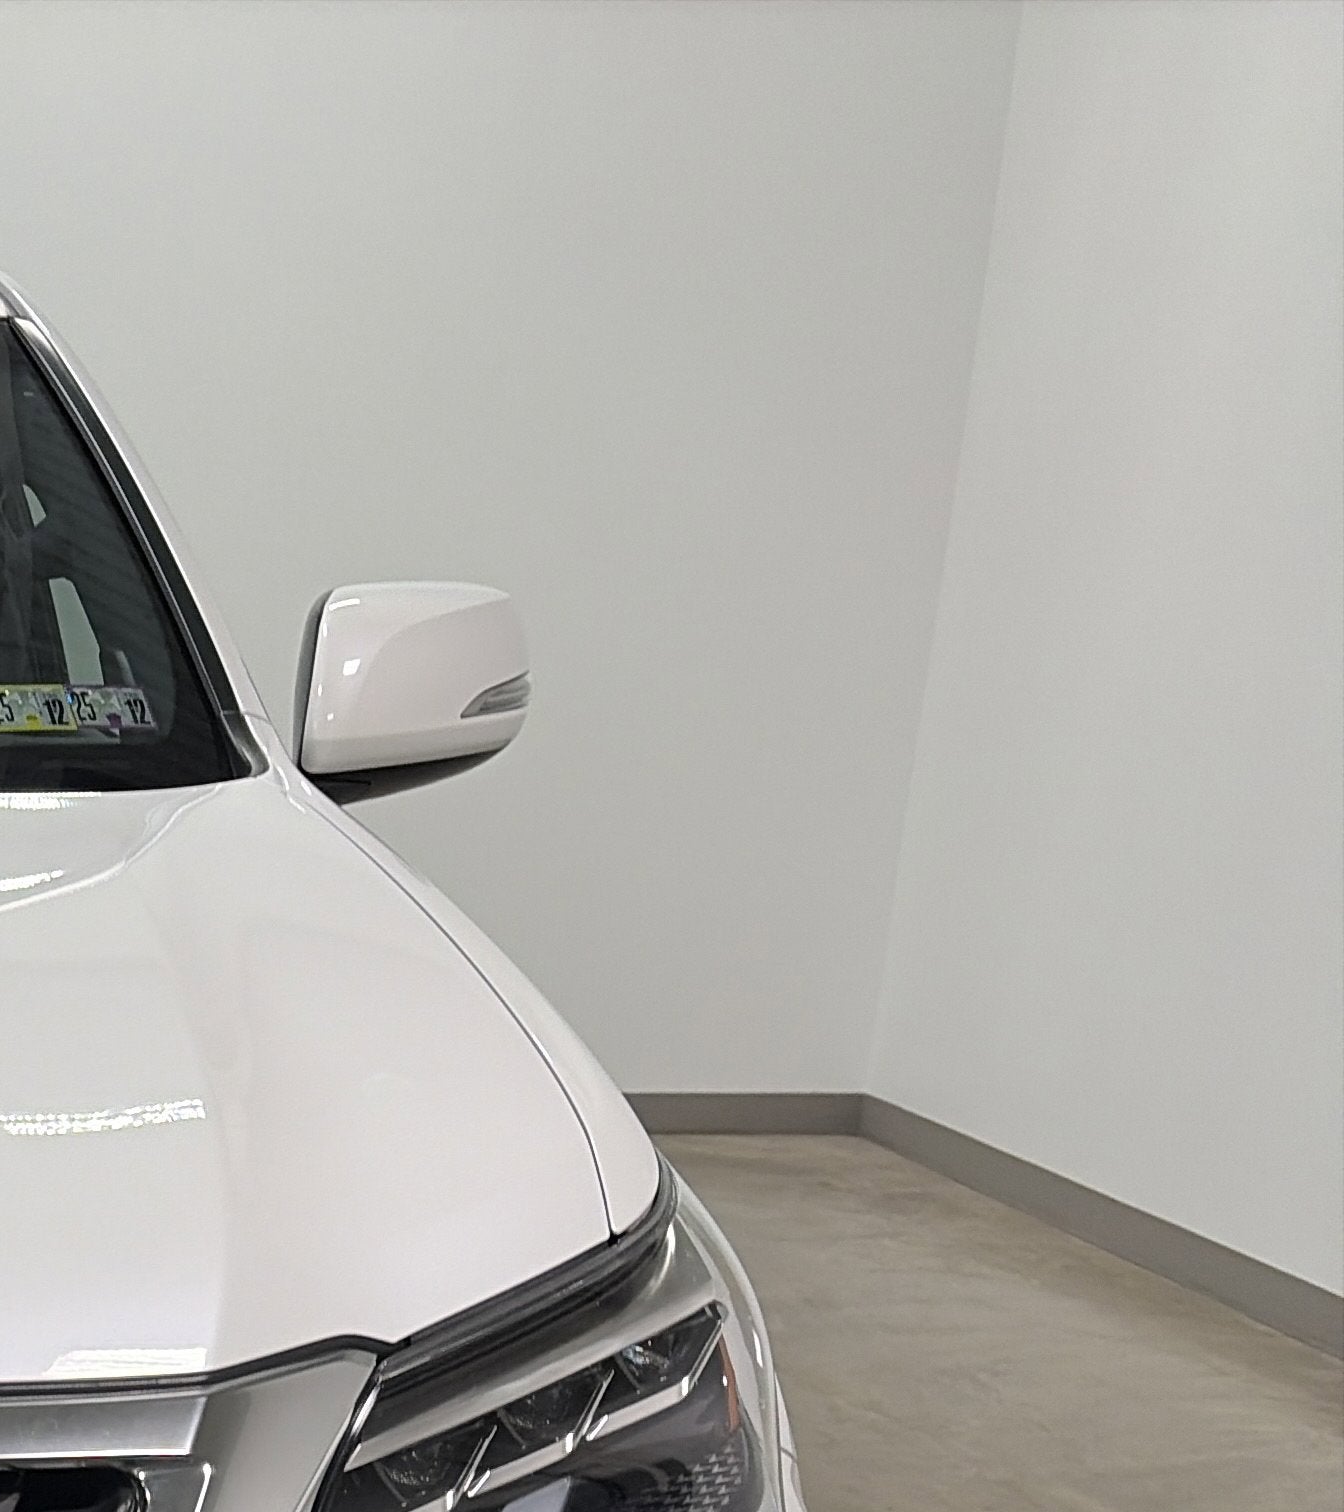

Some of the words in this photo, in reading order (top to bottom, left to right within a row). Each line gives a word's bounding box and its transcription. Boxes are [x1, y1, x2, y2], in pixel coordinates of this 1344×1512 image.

[43, 698, 70, 725] 12
[70, 691, 97, 722] 25
[124, 698, 151, 725] 12
